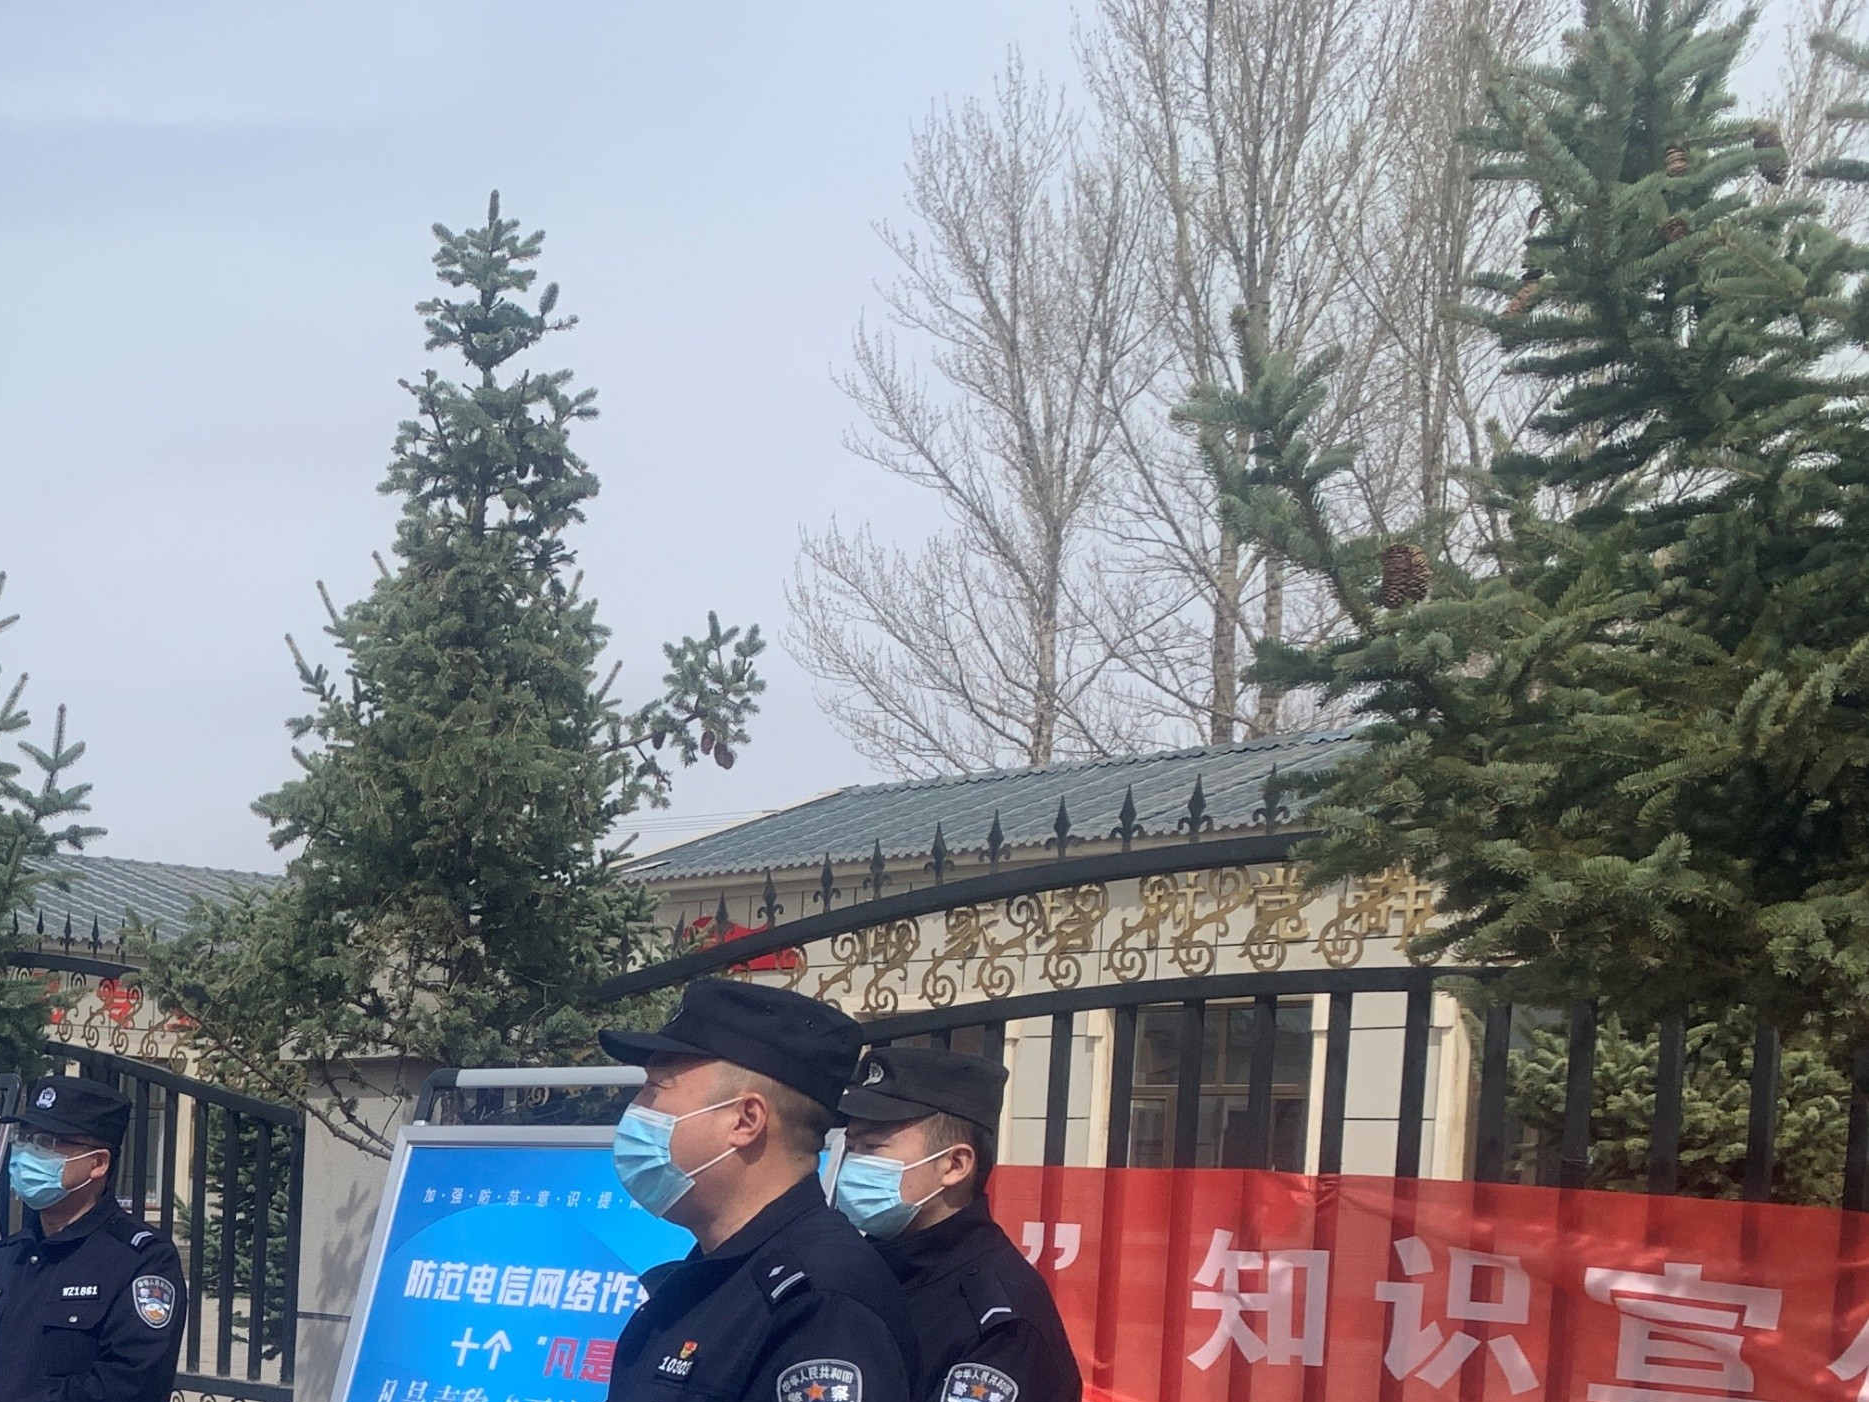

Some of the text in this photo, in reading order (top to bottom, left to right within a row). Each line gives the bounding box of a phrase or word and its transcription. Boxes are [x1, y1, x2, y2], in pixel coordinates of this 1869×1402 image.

[403, 1259, 650, 1315] 防范电信网络诈
[781, 1365, 854, 1393] 中华人民共和国
